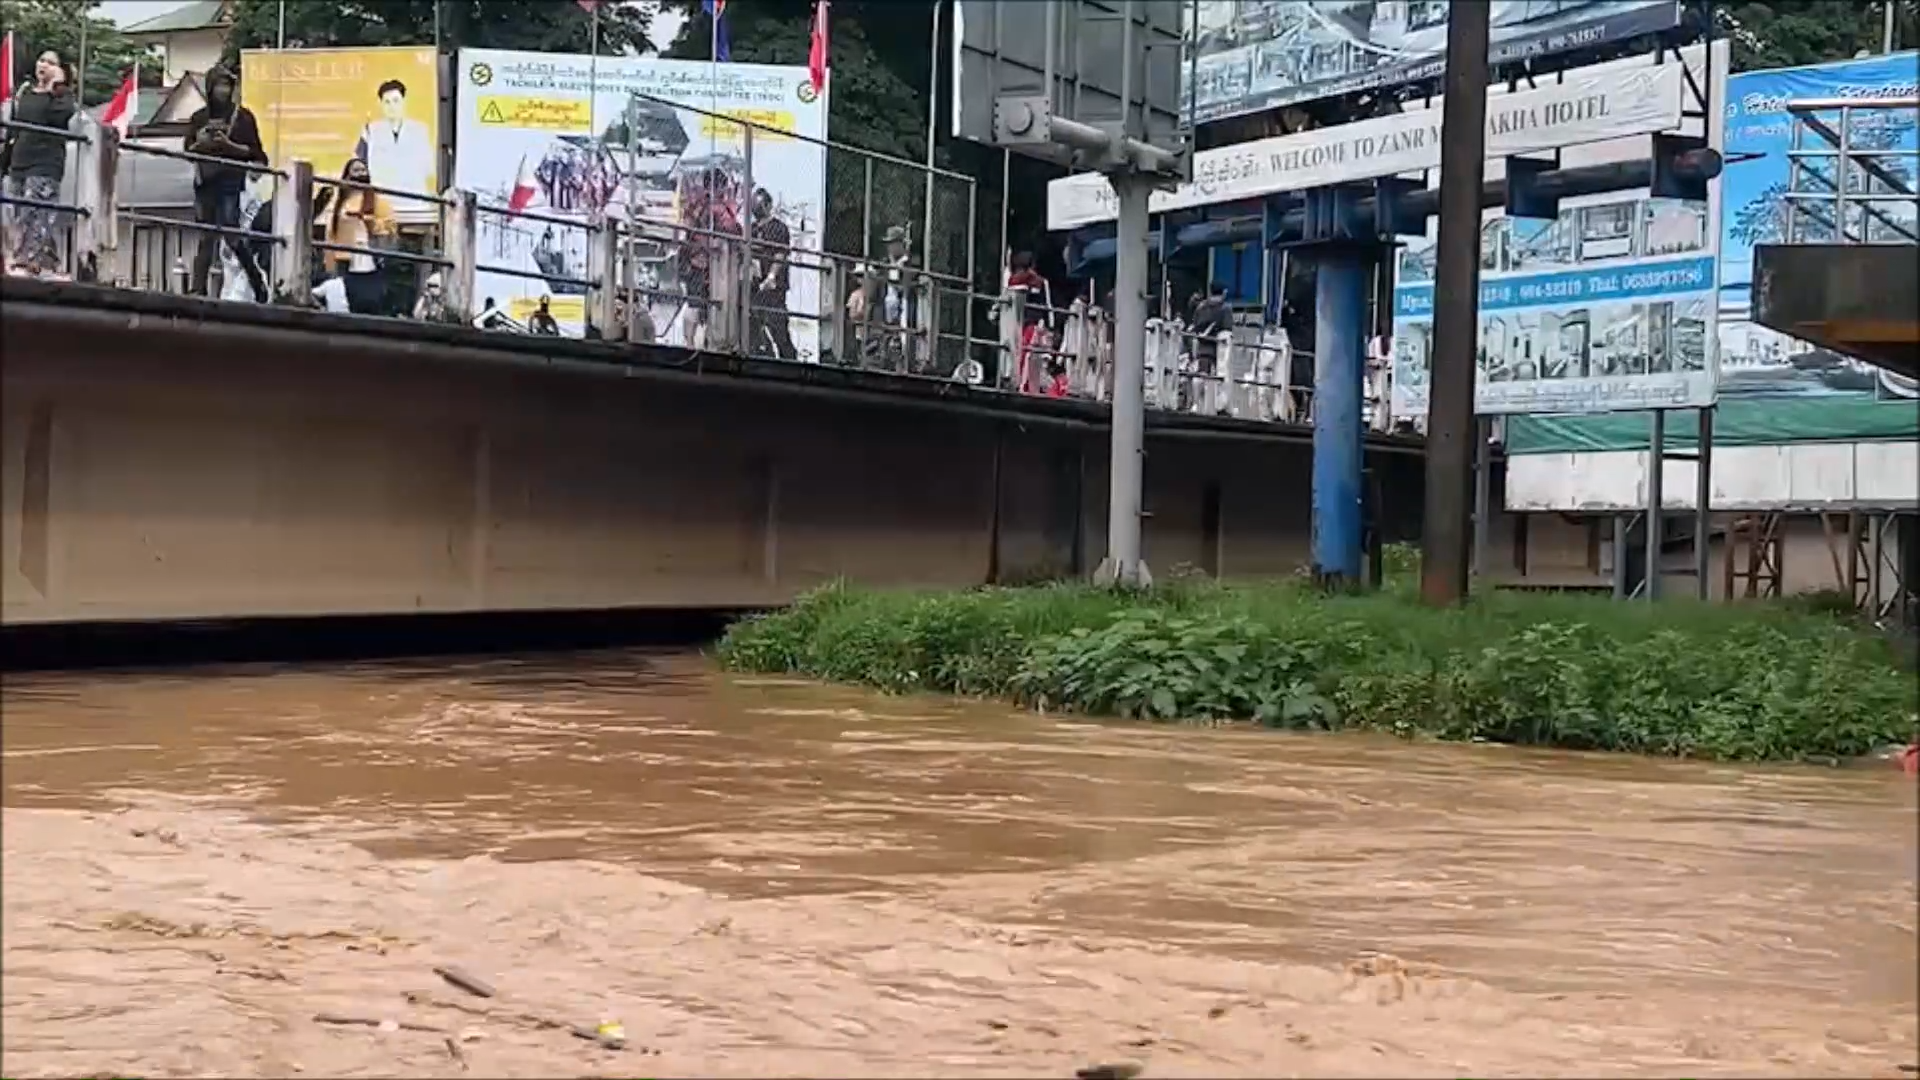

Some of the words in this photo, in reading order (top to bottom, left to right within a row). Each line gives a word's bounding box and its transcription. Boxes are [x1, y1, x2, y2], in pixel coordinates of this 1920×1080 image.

[1271, 141, 1346, 173] WELCOME
[1354, 137, 1374, 160] TO
[1378, 128, 1425, 155] ZANR
[1544, 93, 1612, 127] HOTEL
